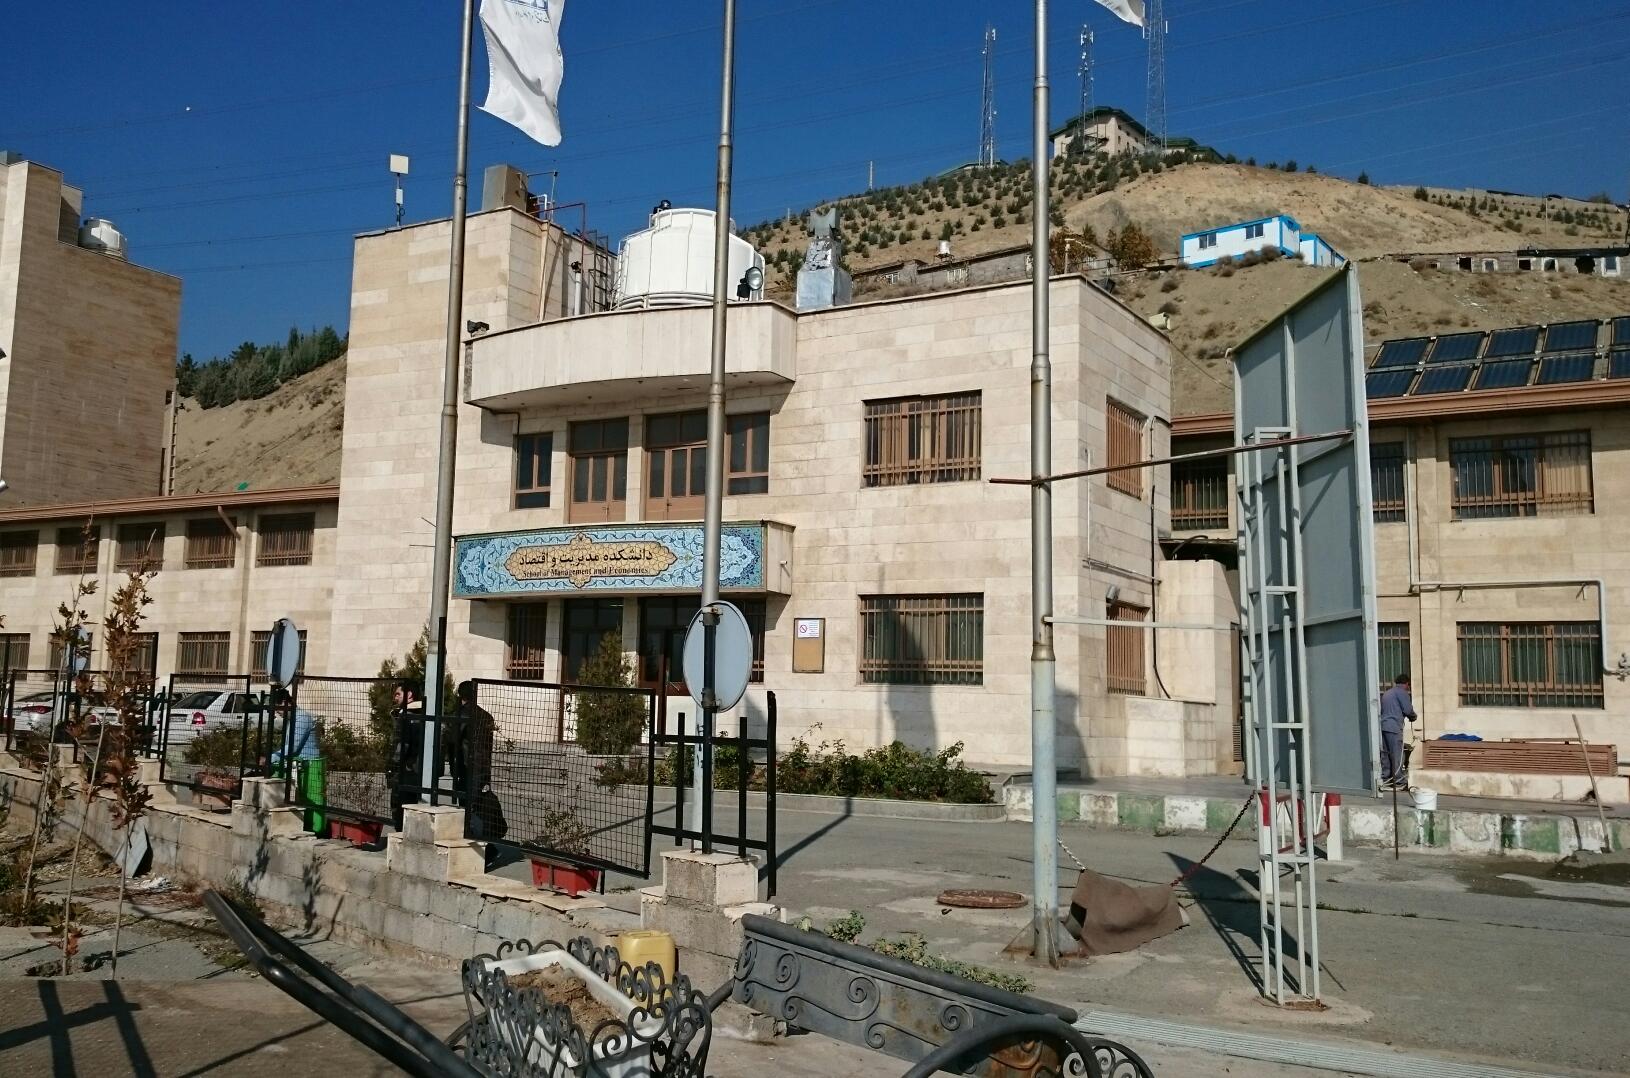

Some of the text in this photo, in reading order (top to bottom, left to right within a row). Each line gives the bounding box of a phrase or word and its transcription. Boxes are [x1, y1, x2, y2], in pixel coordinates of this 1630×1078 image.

[519, 548, 653, 568] دانشکده مدیریت و اقتصاد
[523, 570, 542, 578] School
[550, 567, 592, 578] Management
[593, 566, 607, 575] and
[608, 566, 649, 575] Economics
